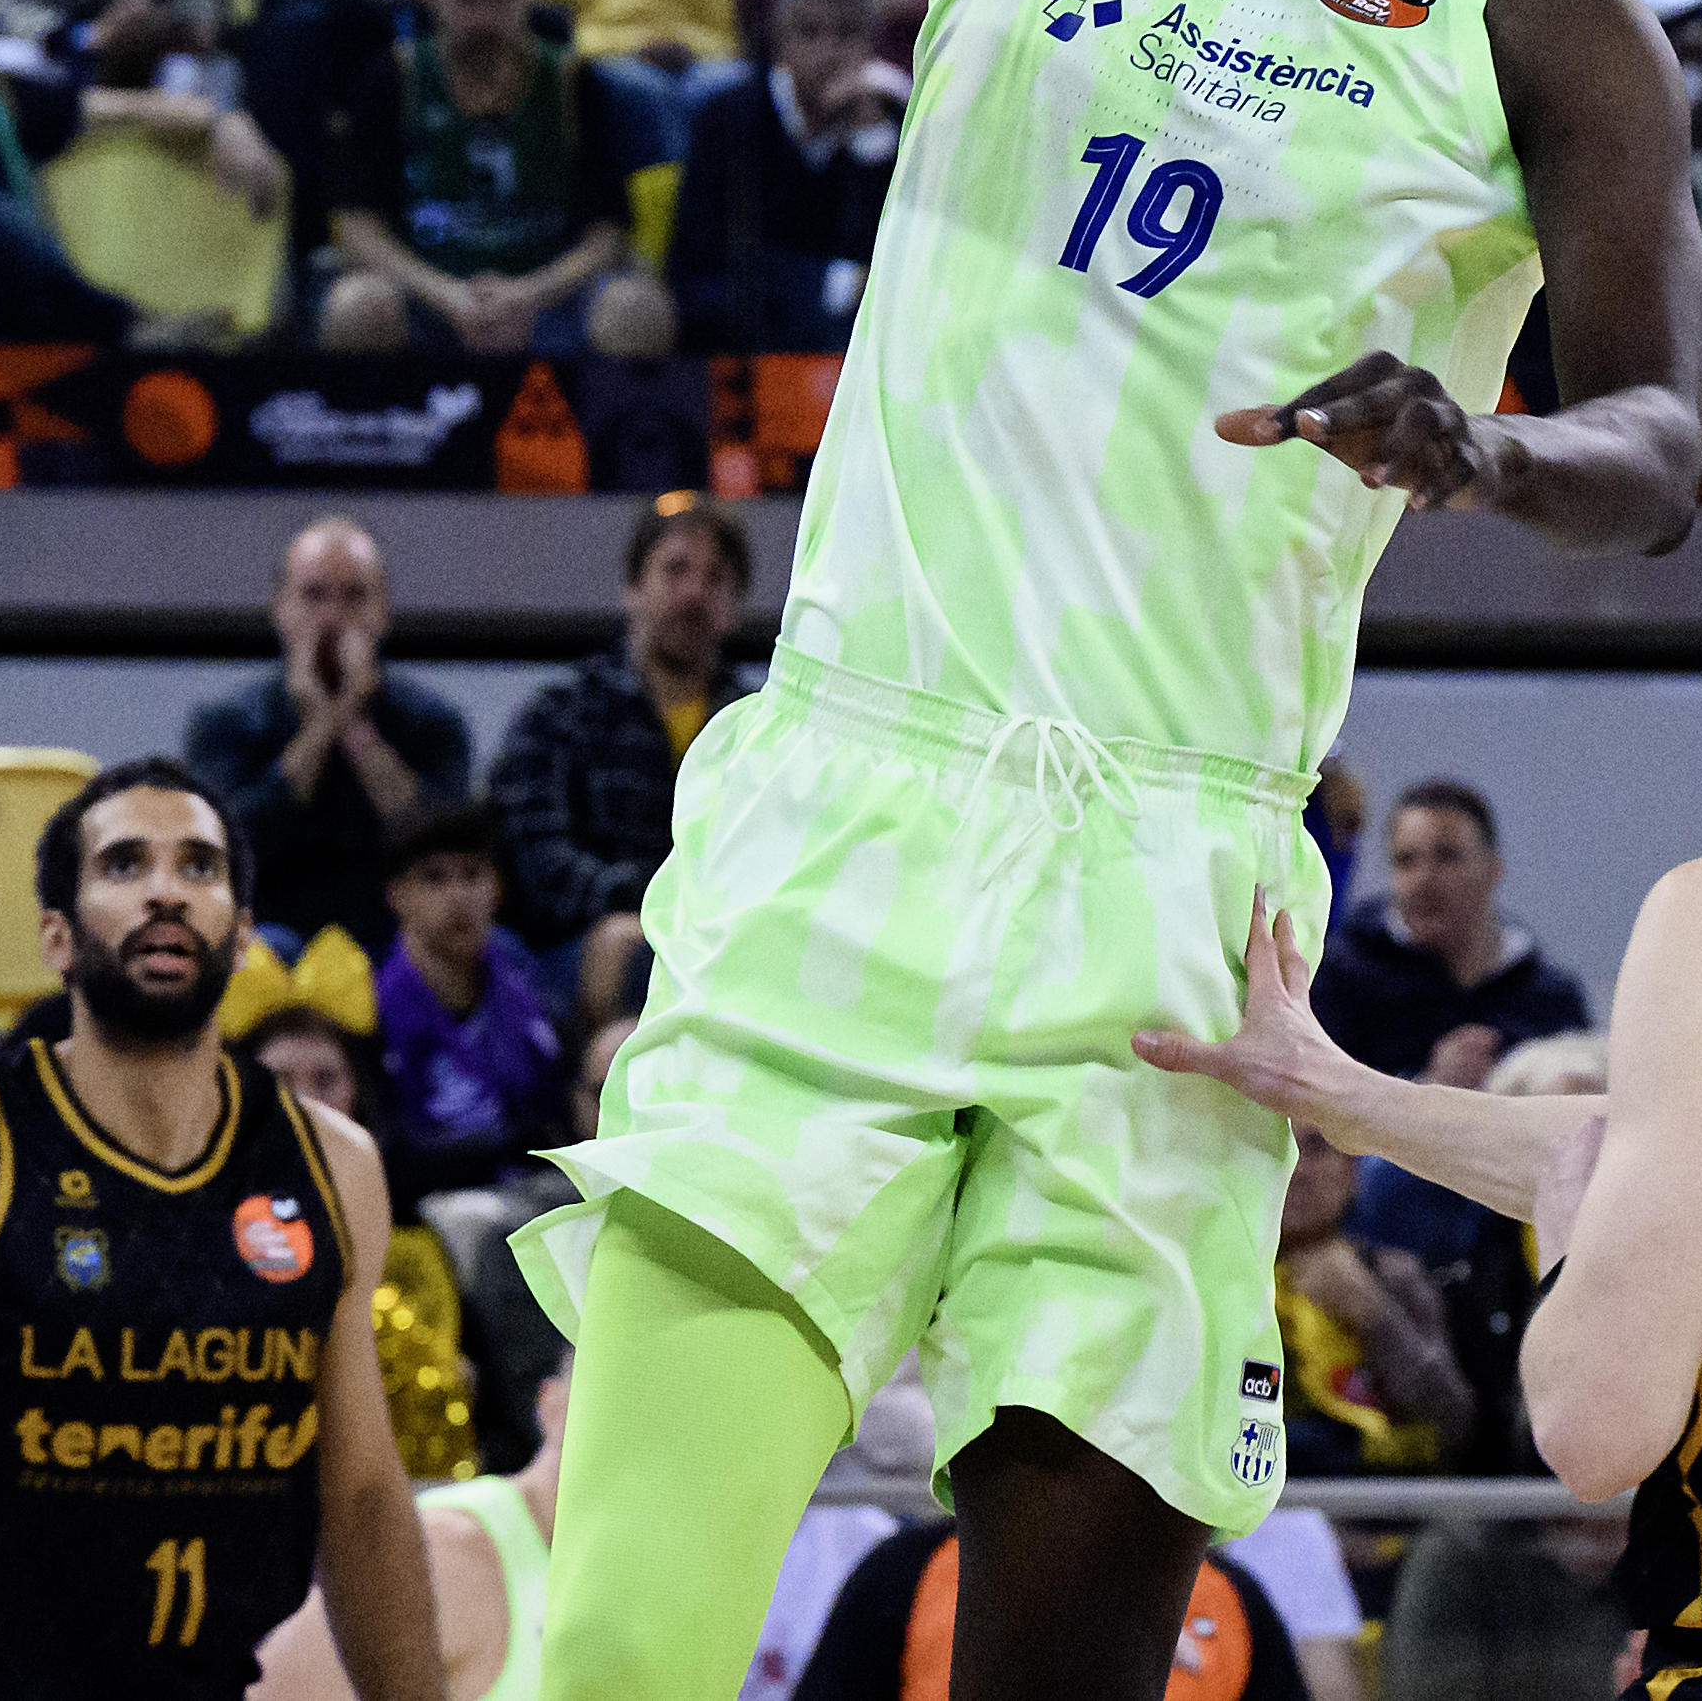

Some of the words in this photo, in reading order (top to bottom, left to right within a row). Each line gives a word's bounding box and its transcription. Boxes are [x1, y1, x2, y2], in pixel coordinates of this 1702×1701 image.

[1130, 34, 1288, 125] Sanitària
[1151, 2, 1376, 109] Assistència
[1058, 132, 1225, 299] 19
[20, 1324, 105, 1381] LA
[120, 1326, 320, 1385] LAGUN
[1245, 1376, 1272, 1397] acb
[14, 1402, 319, 1471] tenerife
[145, 1537, 207, 1647] 11
